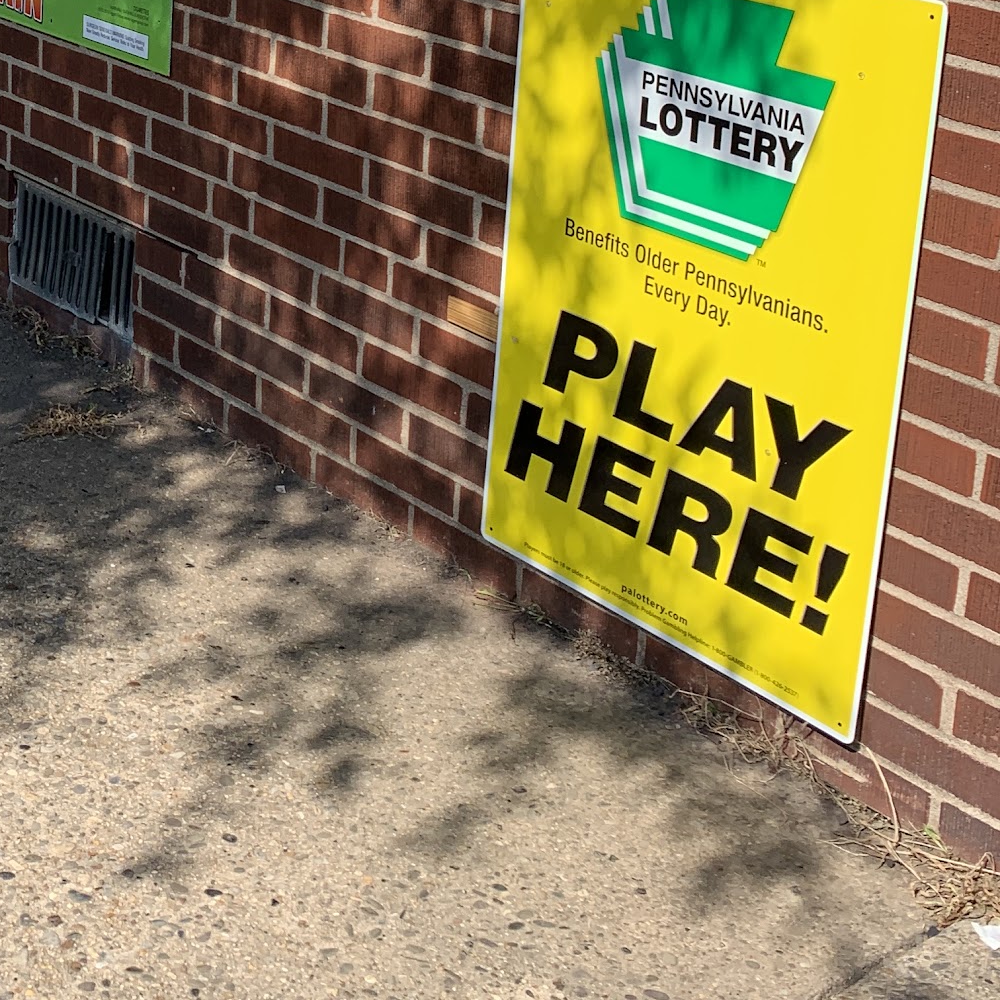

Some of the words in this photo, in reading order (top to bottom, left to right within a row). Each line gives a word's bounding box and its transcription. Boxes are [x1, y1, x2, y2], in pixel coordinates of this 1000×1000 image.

[638, 96, 805, 173] LOTTERY
[641, 70, 806, 136] PENNSYLVANIA
[564, 217, 630, 259] Benefits
[635, 244, 680, 277] Older
[685, 261, 829, 334] Pennsylvanians.
[644, 275, 691, 314] Every
[696, 293, 732, 327] Day.
[542, 310, 853, 501] PLAY
[504, 399, 851, 637] HERE!
[620, 583, 689, 626] palottery.com
[662, 618, 688, 637] Gambling
